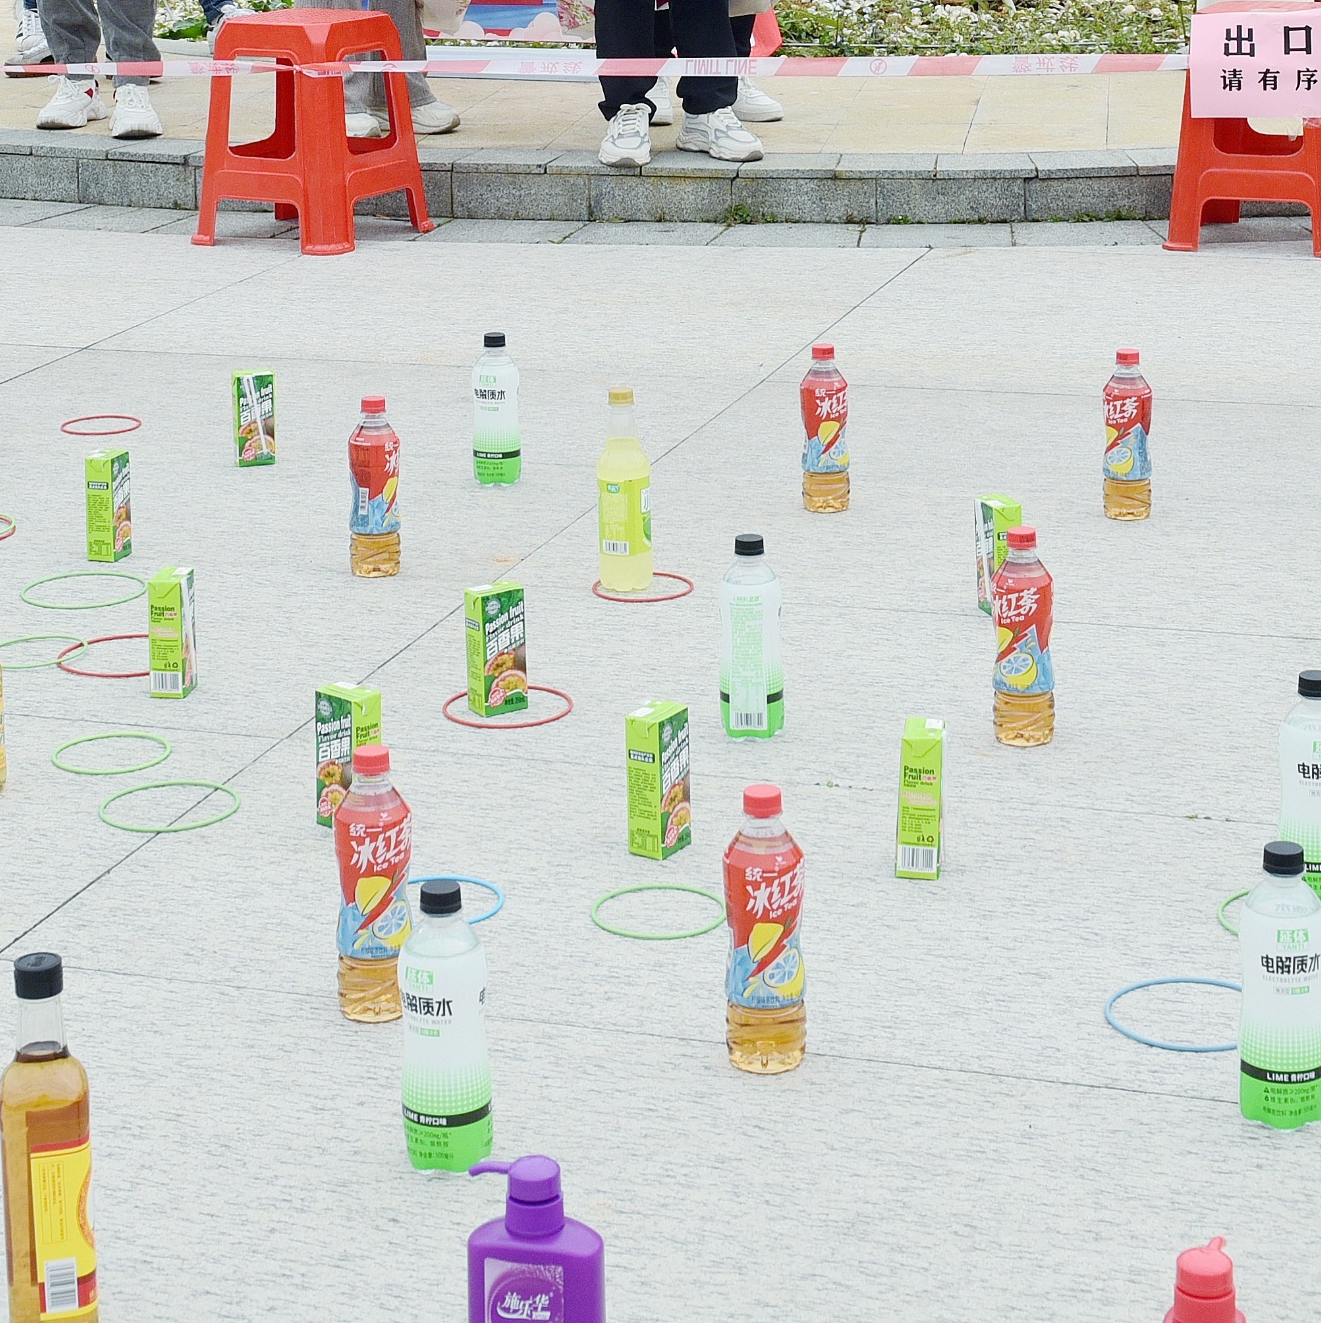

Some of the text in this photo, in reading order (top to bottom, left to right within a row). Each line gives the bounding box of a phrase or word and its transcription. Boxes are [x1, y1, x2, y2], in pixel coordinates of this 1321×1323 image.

[1223, 25, 1313, 57] 出口
[1220, 68, 1318, 91] 请有序
[815, 391, 848, 420] 冰红
[150, 604, 176, 614] Passion
[485, 621, 526, 660] 百香果
[317, 720, 340, 736] Passion
[318, 737, 351, 763] 百香果
[903, 765, 935, 775] Passion
[903, 773, 922, 781] Fruit
[349, 822, 383, 837] 统一
[373, 852, 406, 872] Ice Tea
[745, 866, 779, 882] 统一
[769, 898, 799, 919] Ice Tea
[1260, 953, 1321, 975] 电解质水
[1266, 1072, 1289, 1082] LIME
[501, 1290, 550, 1317] 施乐华
